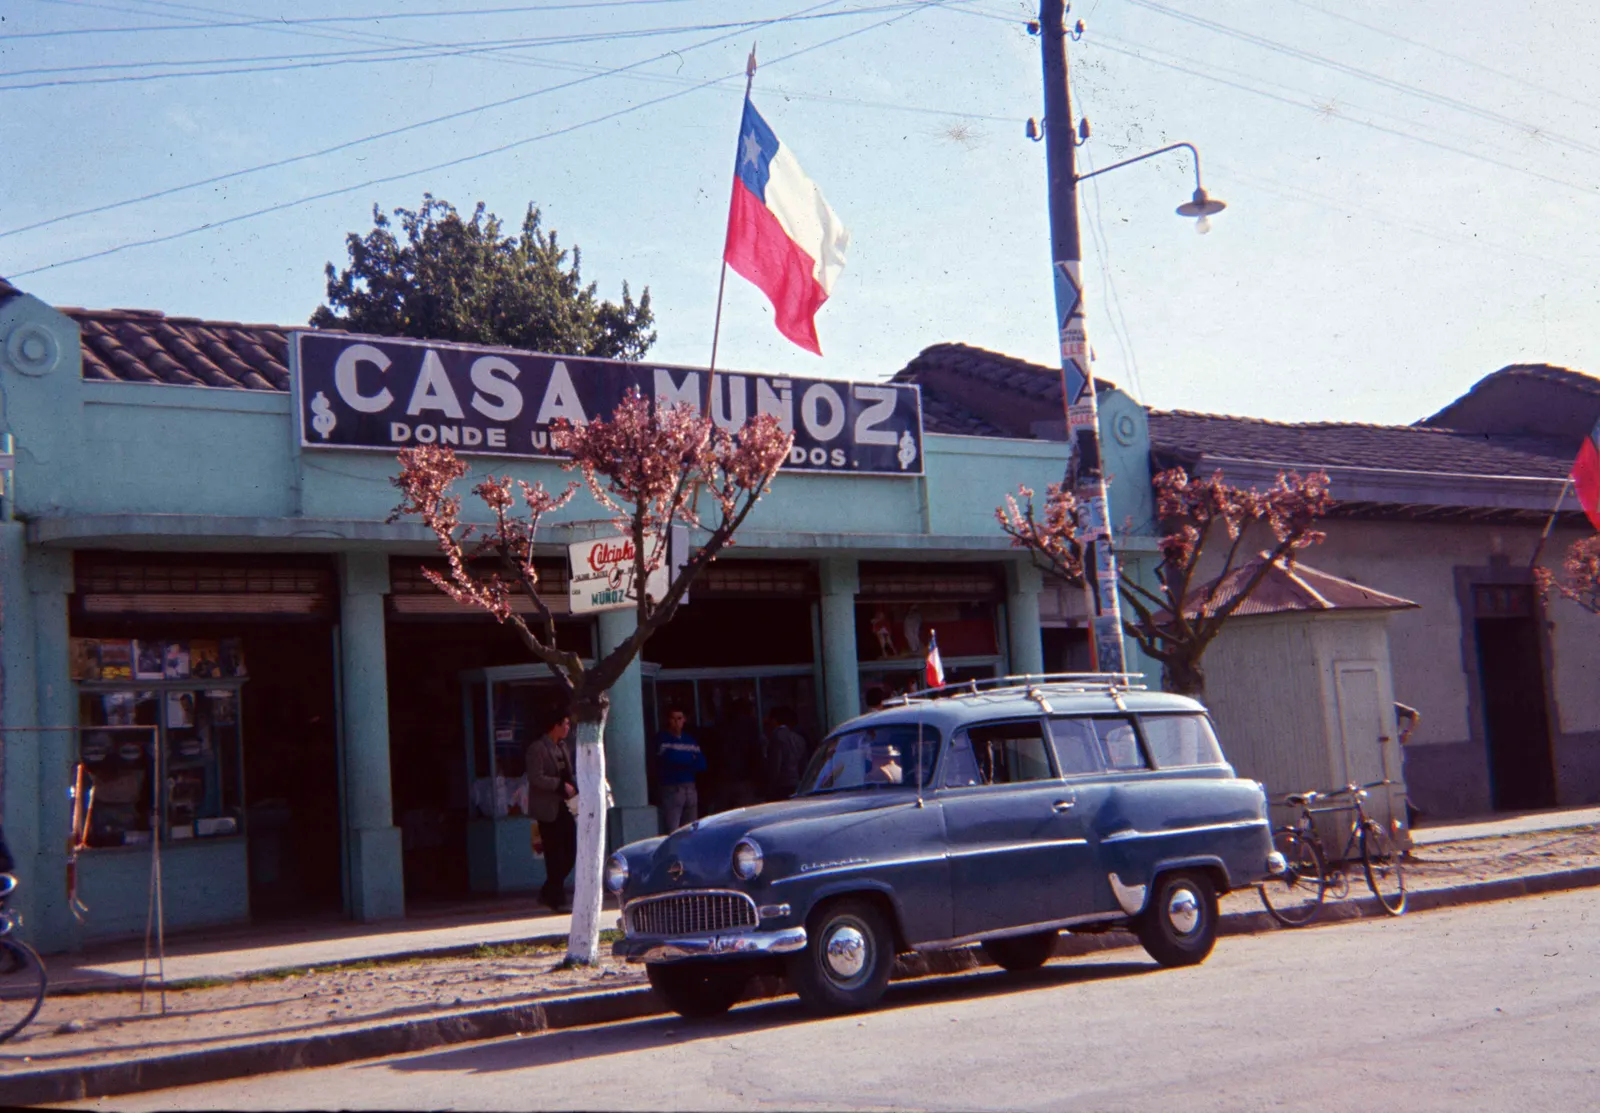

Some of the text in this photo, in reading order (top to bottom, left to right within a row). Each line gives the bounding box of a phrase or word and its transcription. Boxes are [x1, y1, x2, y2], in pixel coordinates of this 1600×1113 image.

[335, 344, 898, 446] CASA MUÑOZ
[391, 422, 507, 448] DONDE
[790, 446, 859, 467] DOS.
